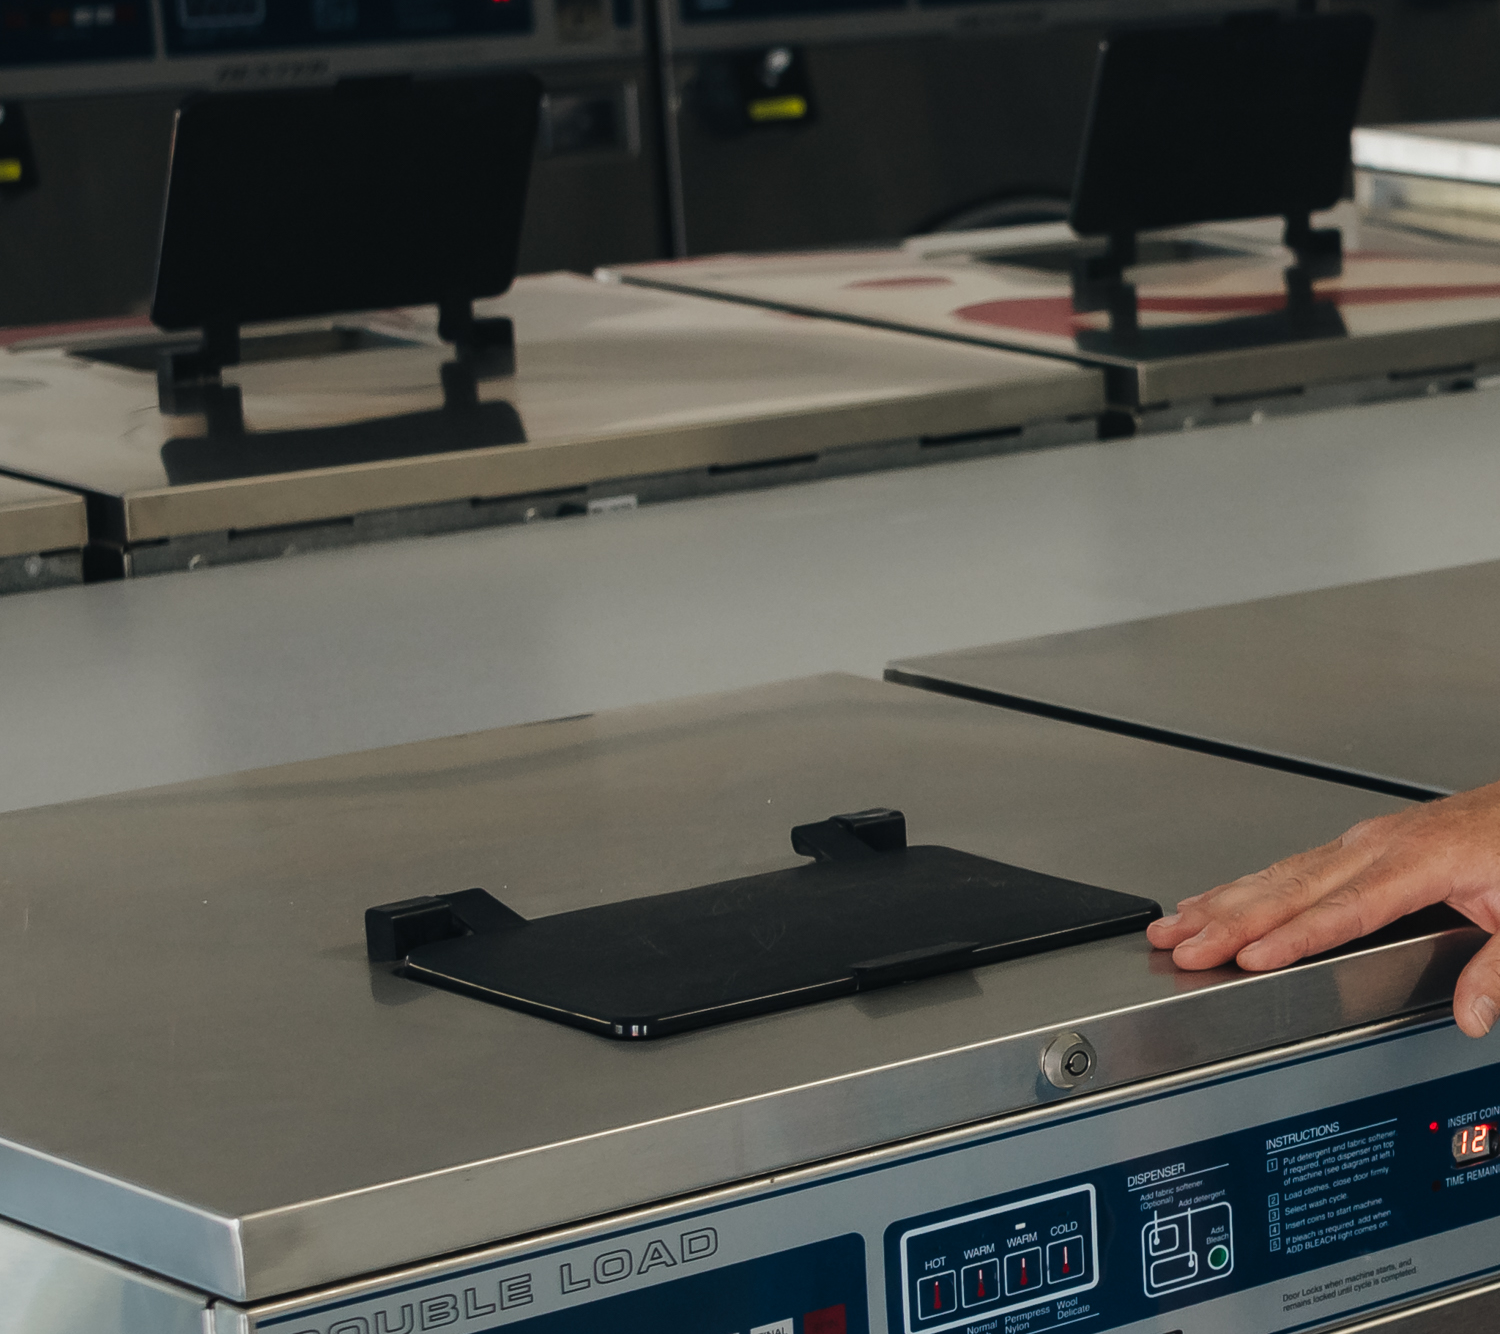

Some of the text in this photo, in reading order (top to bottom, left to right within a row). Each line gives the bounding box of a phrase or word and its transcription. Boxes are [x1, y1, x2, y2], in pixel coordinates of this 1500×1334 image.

[1448, 1111, 1477, 1128] INSERT
[1266, 1122, 1339, 1150] INSTRUCTIONS
[1461, 1124, 1487, 1154] 12
[1283, 1155, 1295, 1165] Put
[1297, 1145, 1330, 1162] detergent
[1332, 1141, 1345, 1152] and
[1347, 1137, 1366, 1148] fabric
[1323, 1155, 1335, 1165] into
[1337, 1147, 1371, 1161] dispenser
[1383, 1140, 1394, 1149] top
[1127, 1162, 1185, 1187] DISPENSER
[1284, 1177, 1290, 1186] of
[1293, 1170, 1322, 1184] machine
[1325, 1166, 1339, 1177] (see
[1342, 1158, 1369, 1170] diagram
[1372, 1153, 1378, 1162] at
[1284, 1189, 1302, 1201] Load
[1333, 1177, 1351, 1188] close
[1353, 1173, 1368, 1182] door
[1446, 1174, 1464, 1187] TIME
[1140, 1191, 1154, 1201] Add
[1155, 1187, 1174, 1197] fabric
[1178, 1197, 1192, 1207] Add
[1141, 1195, 1174, 1212] (Optional)
[1285, 1202, 1307, 1216] Select
[1309, 1197, 1327, 1209] wash
[1286, 1218, 1305, 1230] Insert
[1307, 1214, 1326, 1224] coins
[1327, 1211, 1334, 1219] to
[1336, 1205, 1351, 1216] start
[1050, 1221, 1078, 1236] COLD
[1211, 1226, 1224, 1234] Add
[1293, 1230, 1316, 1243] bleach
[1318, 1228, 1323, 1236] is
[1358, 1215, 1371, 1225] add
[1373, 1211, 1391, 1221] when
[1007, 1232, 1038, 1248] WARM
[1206, 1232, 1229, 1245] Bleach
[1287, 1242, 1303, 1254] ADD
[1305, 1233, 1336, 1249] BLEACH
[1338, 1229, 1353, 1241] light
[1354, 1224, 1377, 1236] comes
[559, 1226, 719, 1295] LOAD
[964, 1243, 995, 1260] WARM
[925, 1256, 946, 1270] HOT
[1283, 1292, 1300, 1302] Door
[1302, 1285, 1322, 1296] Locks
[1324, 1279, 1343, 1290] when
[1345, 1270, 1374, 1284] machine
[1398, 1258, 1412, 1269] and
[1283, 1266, 1416, 1312] remains locked until cycle is completed
[1057, 1297, 1078, 1310] Wool
[1057, 1304, 1090, 1320] Delicate
[1005, 1306, 1050, 1324] Permpress
[1005, 1321, 1030, 1334] Nylon
